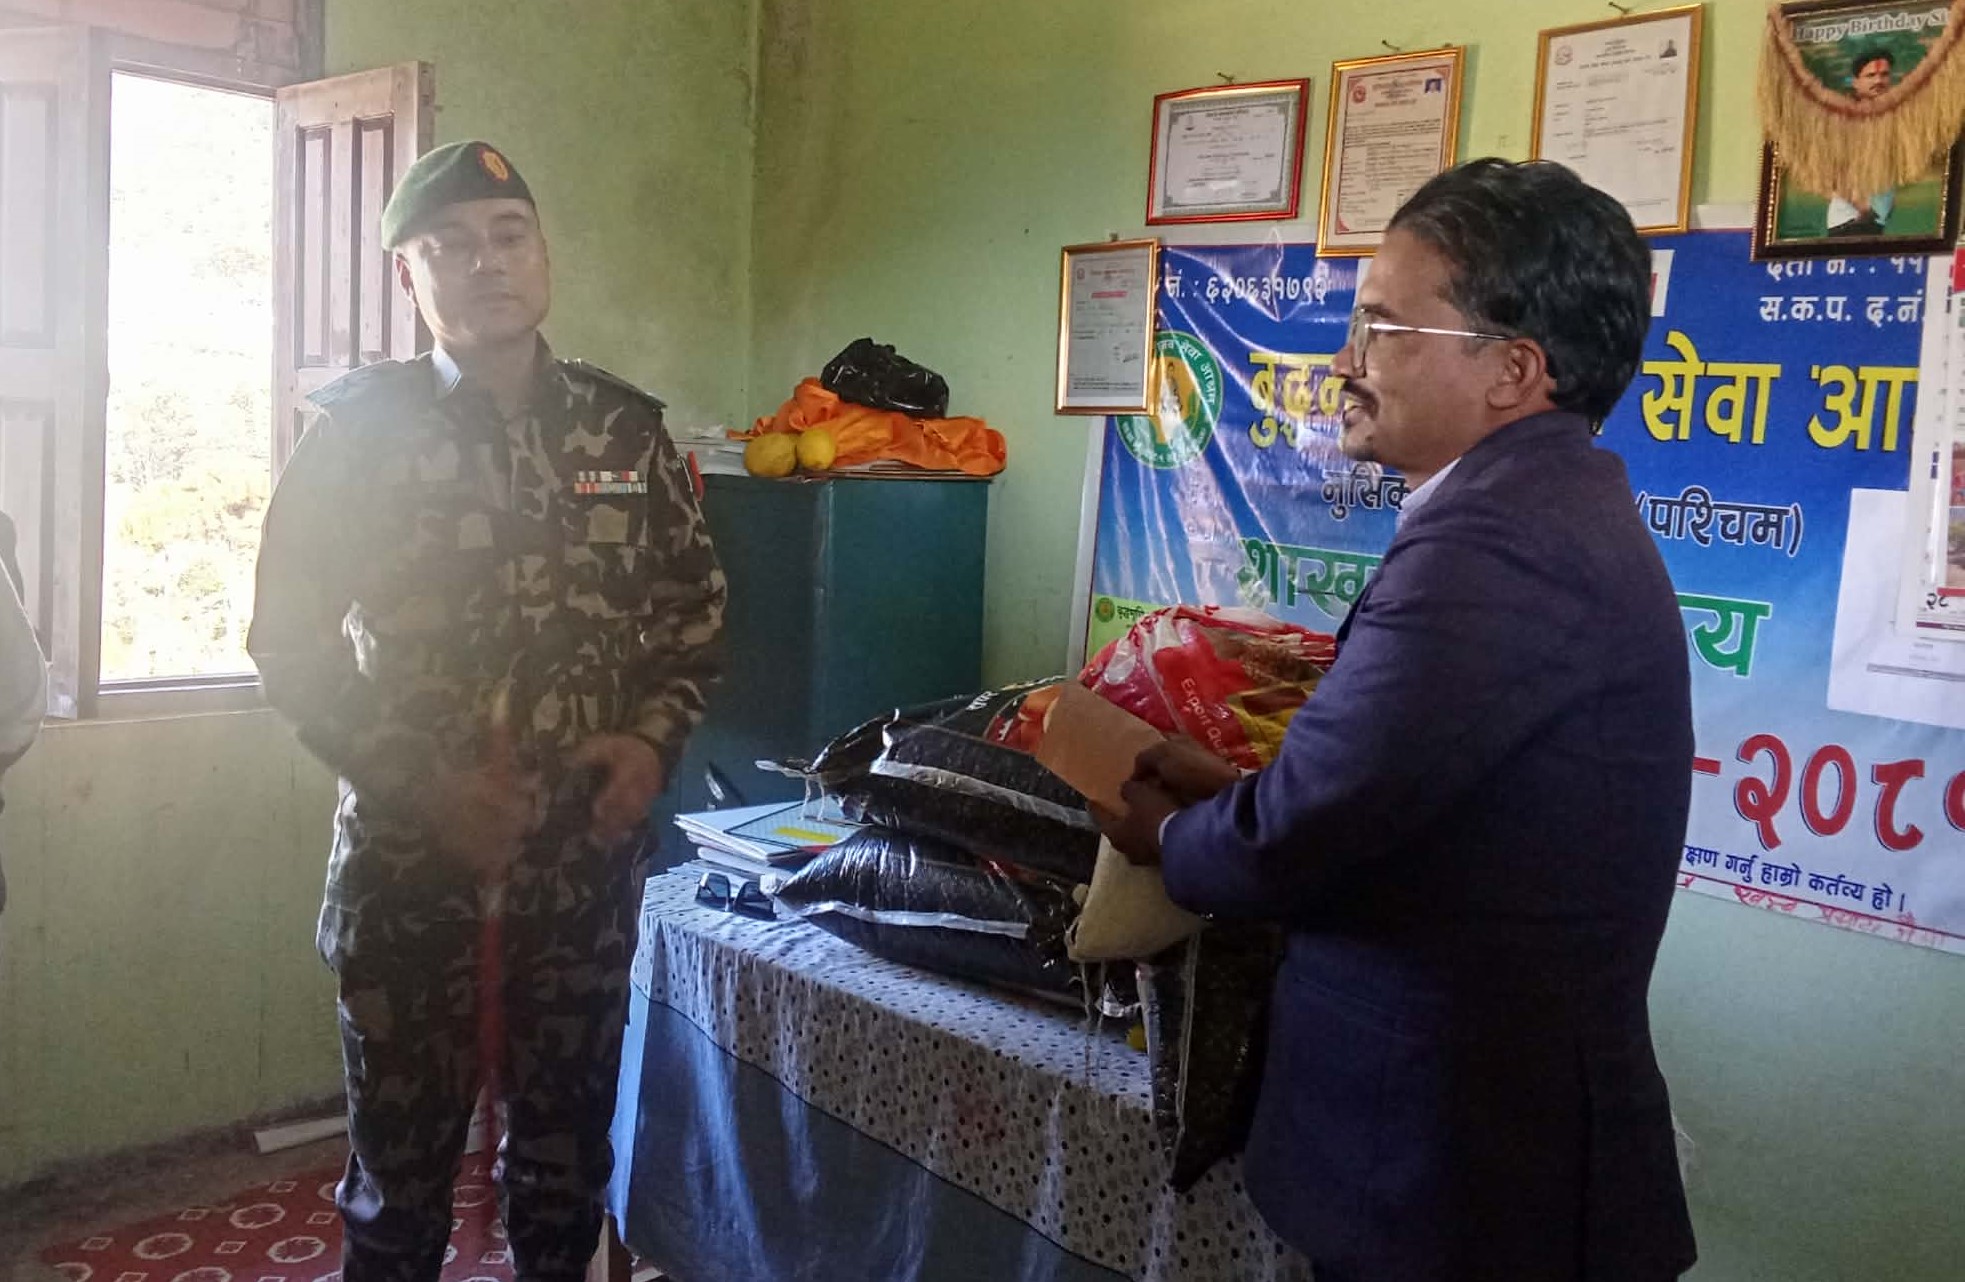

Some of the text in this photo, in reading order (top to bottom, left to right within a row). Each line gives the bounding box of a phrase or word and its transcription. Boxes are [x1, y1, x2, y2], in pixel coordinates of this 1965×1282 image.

[1849, 12, 1927, 36] Birthday
[1759, 294, 1853, 323] स.क.प.
[1642, 329, 1782, 445] सेवा
[1807, 364, 1919, 452] आ
[1181, 676, 1214, 727] Export
[1682, 844, 1720, 868] क्षण
[1760, 862, 1802, 887] हाम्रो
[1808, 871, 1867, 902] कर्तव्य
